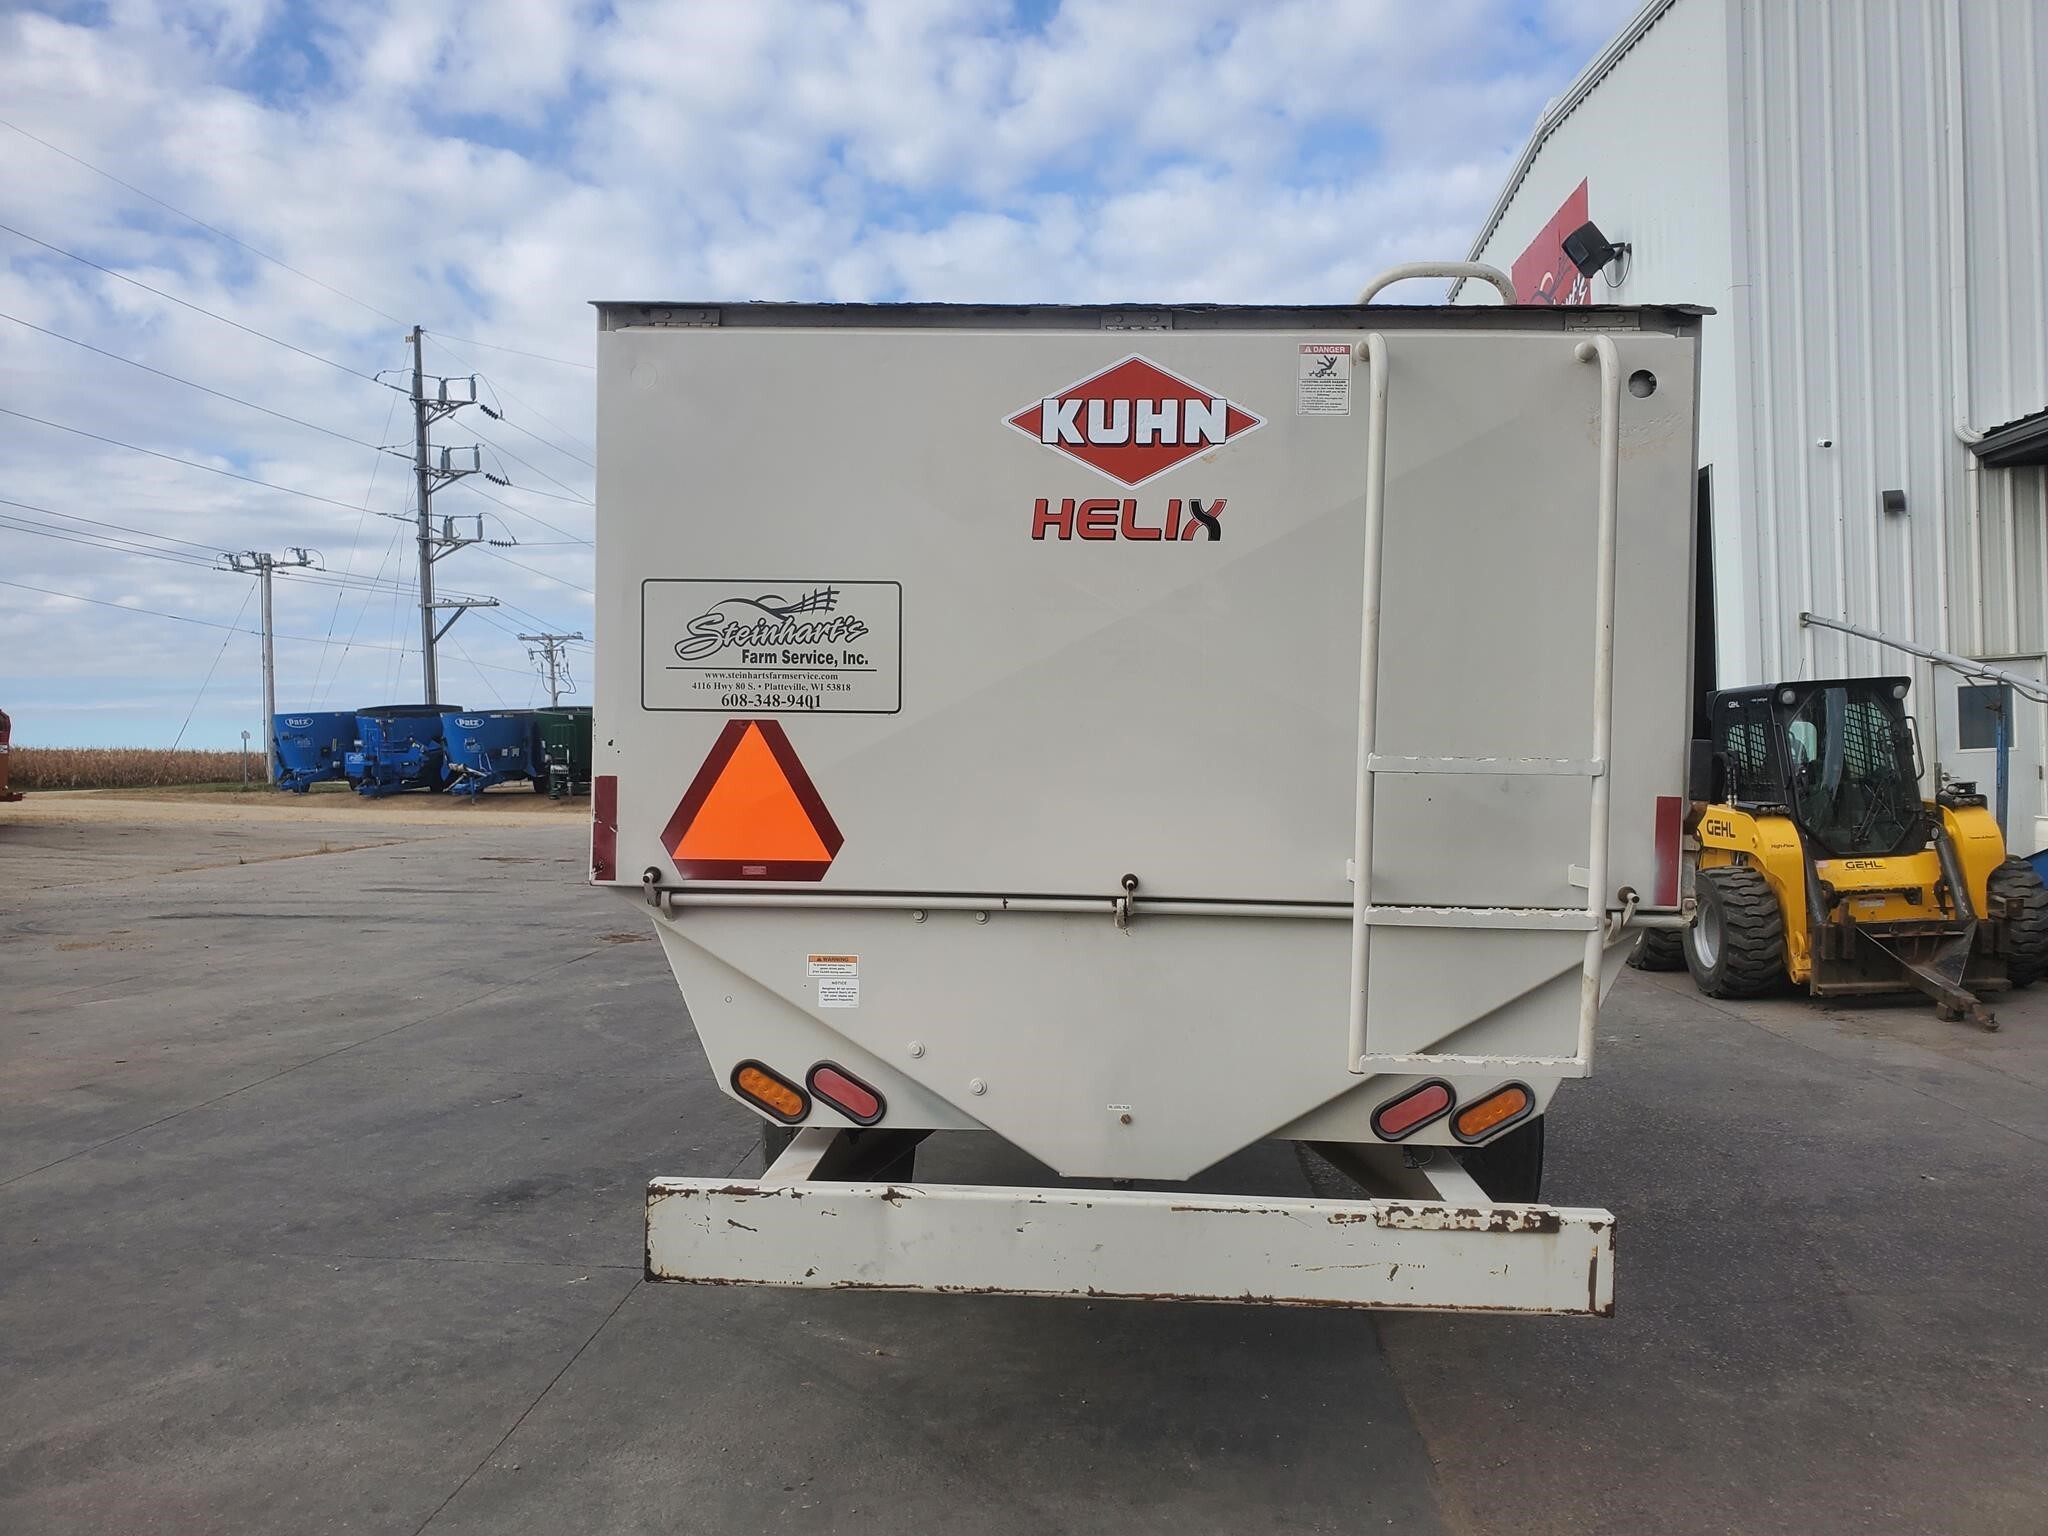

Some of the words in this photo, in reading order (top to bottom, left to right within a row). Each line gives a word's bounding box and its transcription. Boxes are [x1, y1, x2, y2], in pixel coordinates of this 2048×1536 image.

[1313, 346, 1346, 354] DANGER
[1041, 398, 1228, 446] KUHN
[1031, 498, 1228, 542] HELIX
[675, 612, 869, 661] Steinhart's
[742, 650, 778, 665] Farm
[782, 650, 838, 667] Service,
[843, 651, 869, 665] Inc.
[705, 672, 839, 680] www.steinhartsfarmservice.com
[692, 682, 711, 690] 4116
[714, 682, 733, 692] Hwy
[735, 682, 746, 690] 80
[748, 682, 756, 691] S.
[764, 683, 809, 691] Platteville,
[811, 683, 824, 691] WI
[826, 683, 852, 691] 53818
[721, 693, 821, 709] 608-348-9401
[1706, 819, 1736, 838] GEHL
[1845, 860, 1883, 869] GEHL
